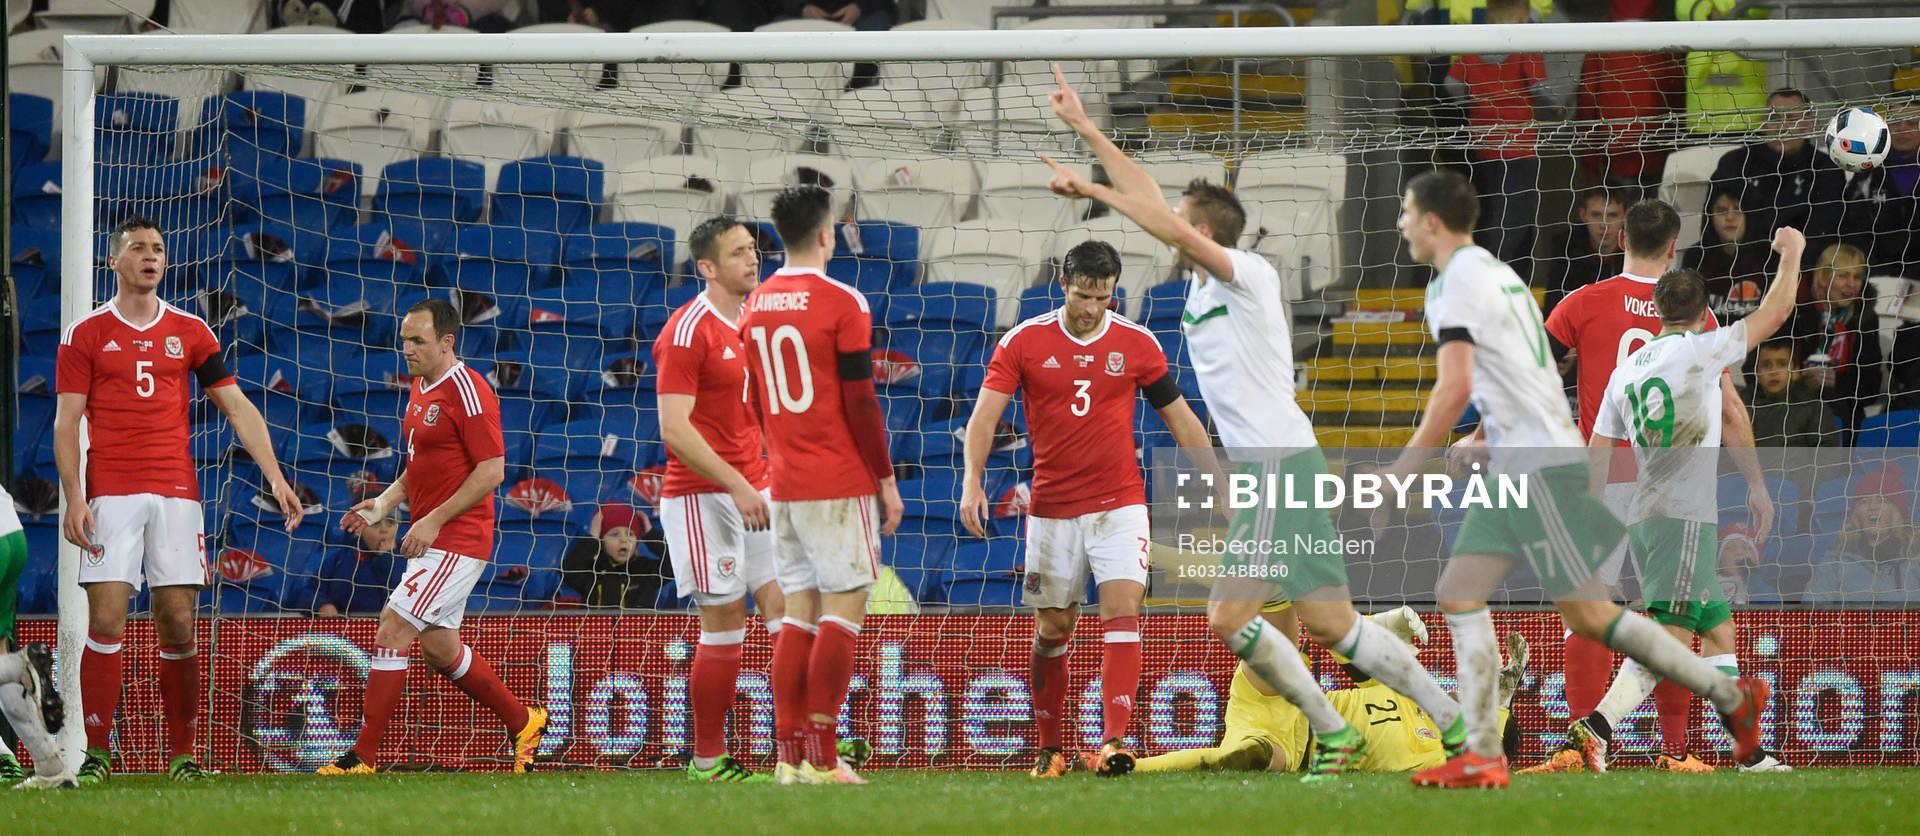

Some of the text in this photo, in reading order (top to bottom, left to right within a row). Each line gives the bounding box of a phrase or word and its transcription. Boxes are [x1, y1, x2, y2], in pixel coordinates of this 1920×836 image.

[750, 291, 811, 312] LAWRENCE
[136, 360, 155, 398] 5
[751, 324, 814, 415] 10
[1071, 379, 1092, 417] 3
[1624, 377, 1675, 457] 19
[1137, 536, 1150, 570] 3
[1521, 539, 1556, 579] 17
[404, 568, 428, 598] 4
[1365, 699, 1402, 726] 21
